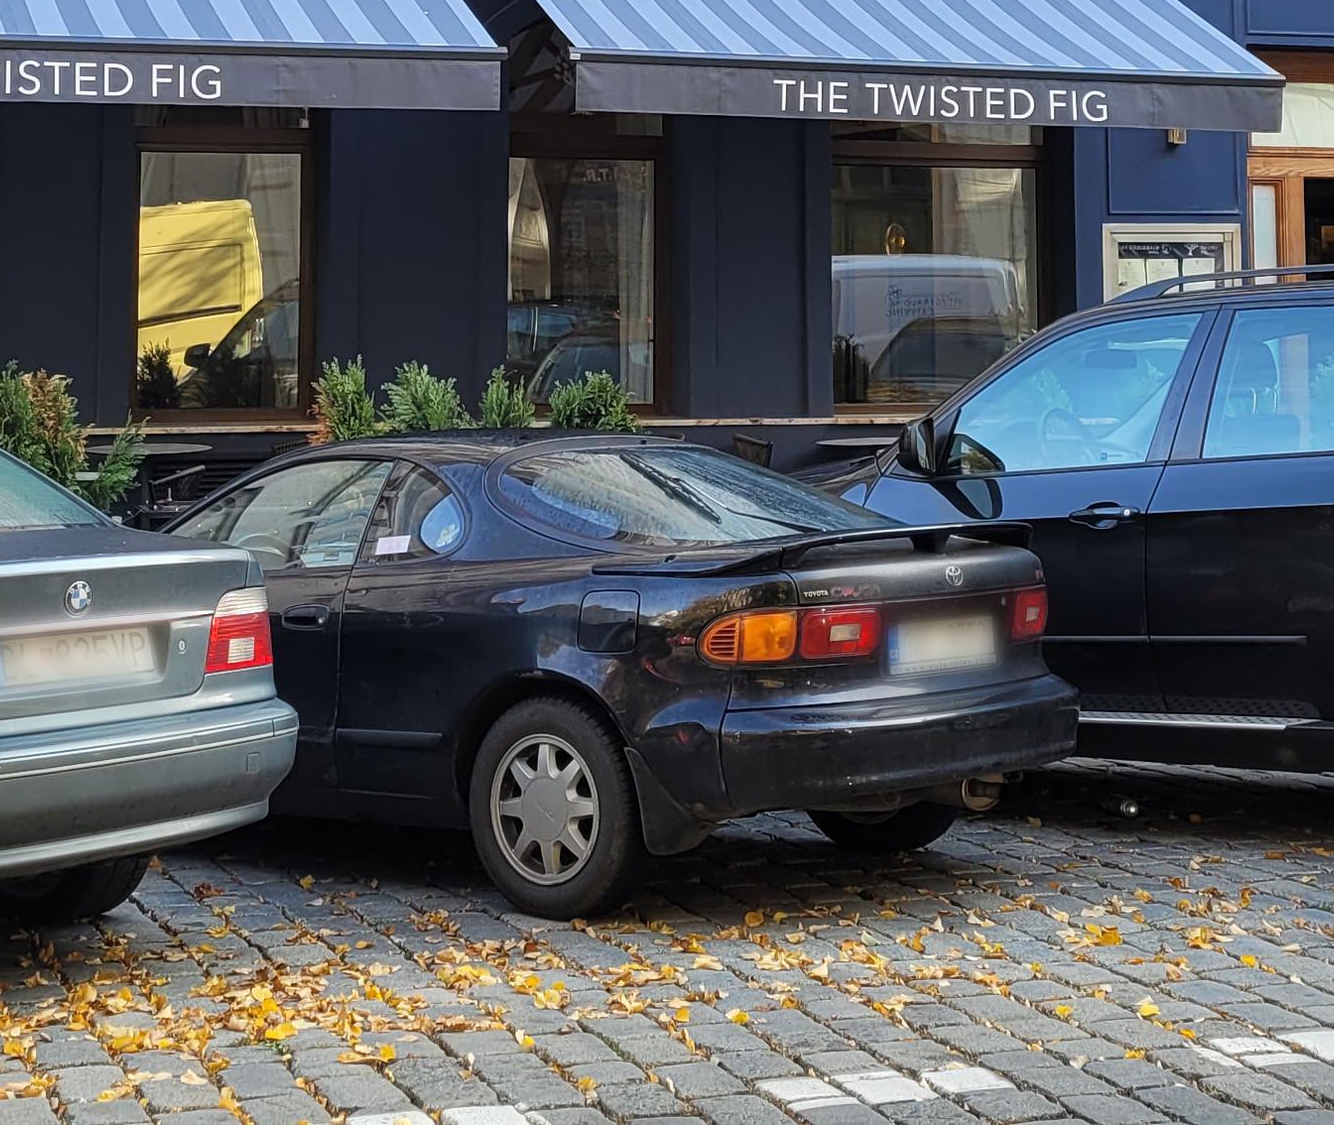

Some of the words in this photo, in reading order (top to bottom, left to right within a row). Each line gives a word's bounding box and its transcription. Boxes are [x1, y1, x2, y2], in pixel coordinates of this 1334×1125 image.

[151, 63, 222, 100] FIG
[773, 79, 849, 114] THE
[864, 82, 1035, 119] TWISTED
[1049, 89, 1108, 122] FIG
[803, 589, 829, 598] TOYOTA
